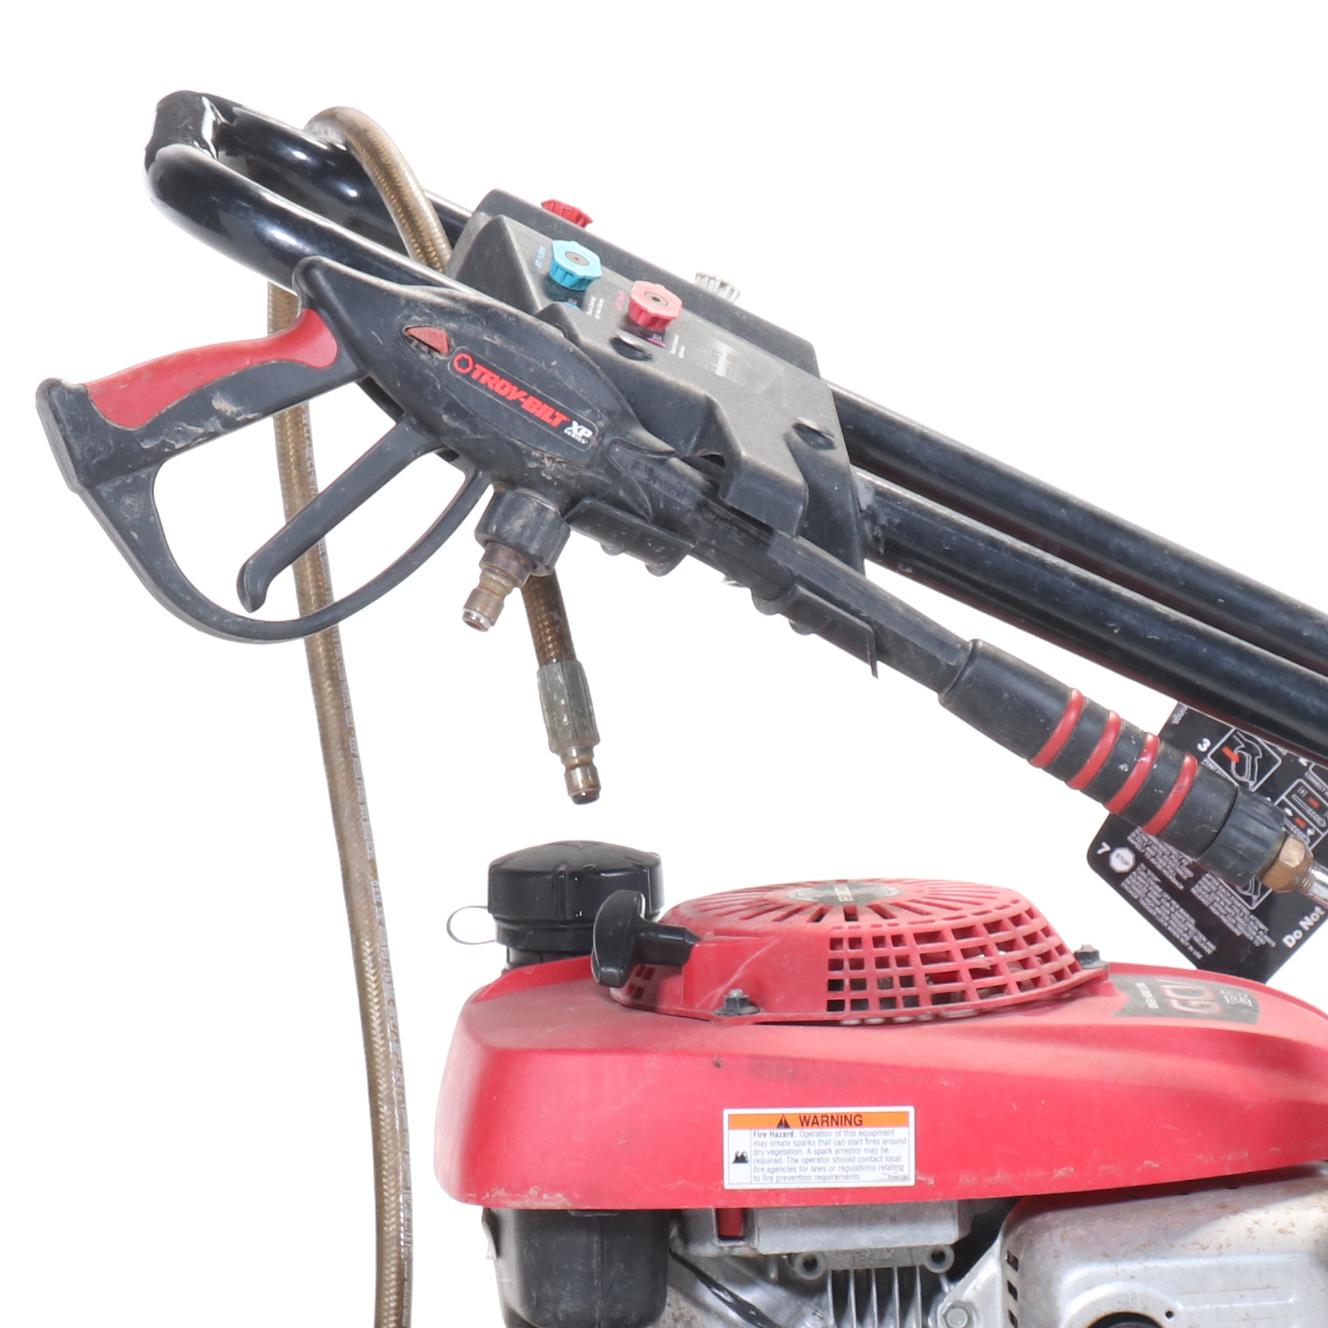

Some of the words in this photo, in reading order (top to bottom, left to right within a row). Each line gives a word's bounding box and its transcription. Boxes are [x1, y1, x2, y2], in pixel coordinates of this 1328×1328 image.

[470, 363, 570, 428] TROY-BILT
[564, 420, 593, 438] XP
[1197, 738, 1211, 752] 3
[1097, 842, 1111, 854] 7
[1282, 929, 1303, 948] Do
[1299, 906, 1325, 931] Not
[798, 1113, 864, 1127] WARNING
[753, 1130, 767, 1138] Fire
[800, 1130, 833, 1139] Operation
[835, 1129, 842, 1137] of
[844, 1129, 856, 1137] this
[859, 1129, 895, 1138] equipment
[753, 1140, 767, 1148] may
[793, 1138, 815, 1148] sparks
[817, 1138, 831, 1146] that
[865, 1137, 880, 1145] fires
[882, 1137, 906, 1145] around
[753, 1148, 765, 1156] dry
[814, 1147, 832, 1156] spark
[864, 1147, 880, 1155] may
[880, 1146, 888, 1154] be
[787, 1156, 799, 1164] The
[801, 1156, 829, 1165] operator
[833, 1155, 855, 1163] should
[885, 1154, 901, 1162] local
[753, 1165, 764, 1173] fire
[767, 1165, 797, 1174] agencies
[811, 1164, 826, 1172] laws
[838, 1164, 876, 1173] regulations
[878, 1163, 904, 1172] relating
[753, 1174, 760, 1182] to
[776, 1174, 812, 1183] prevention
